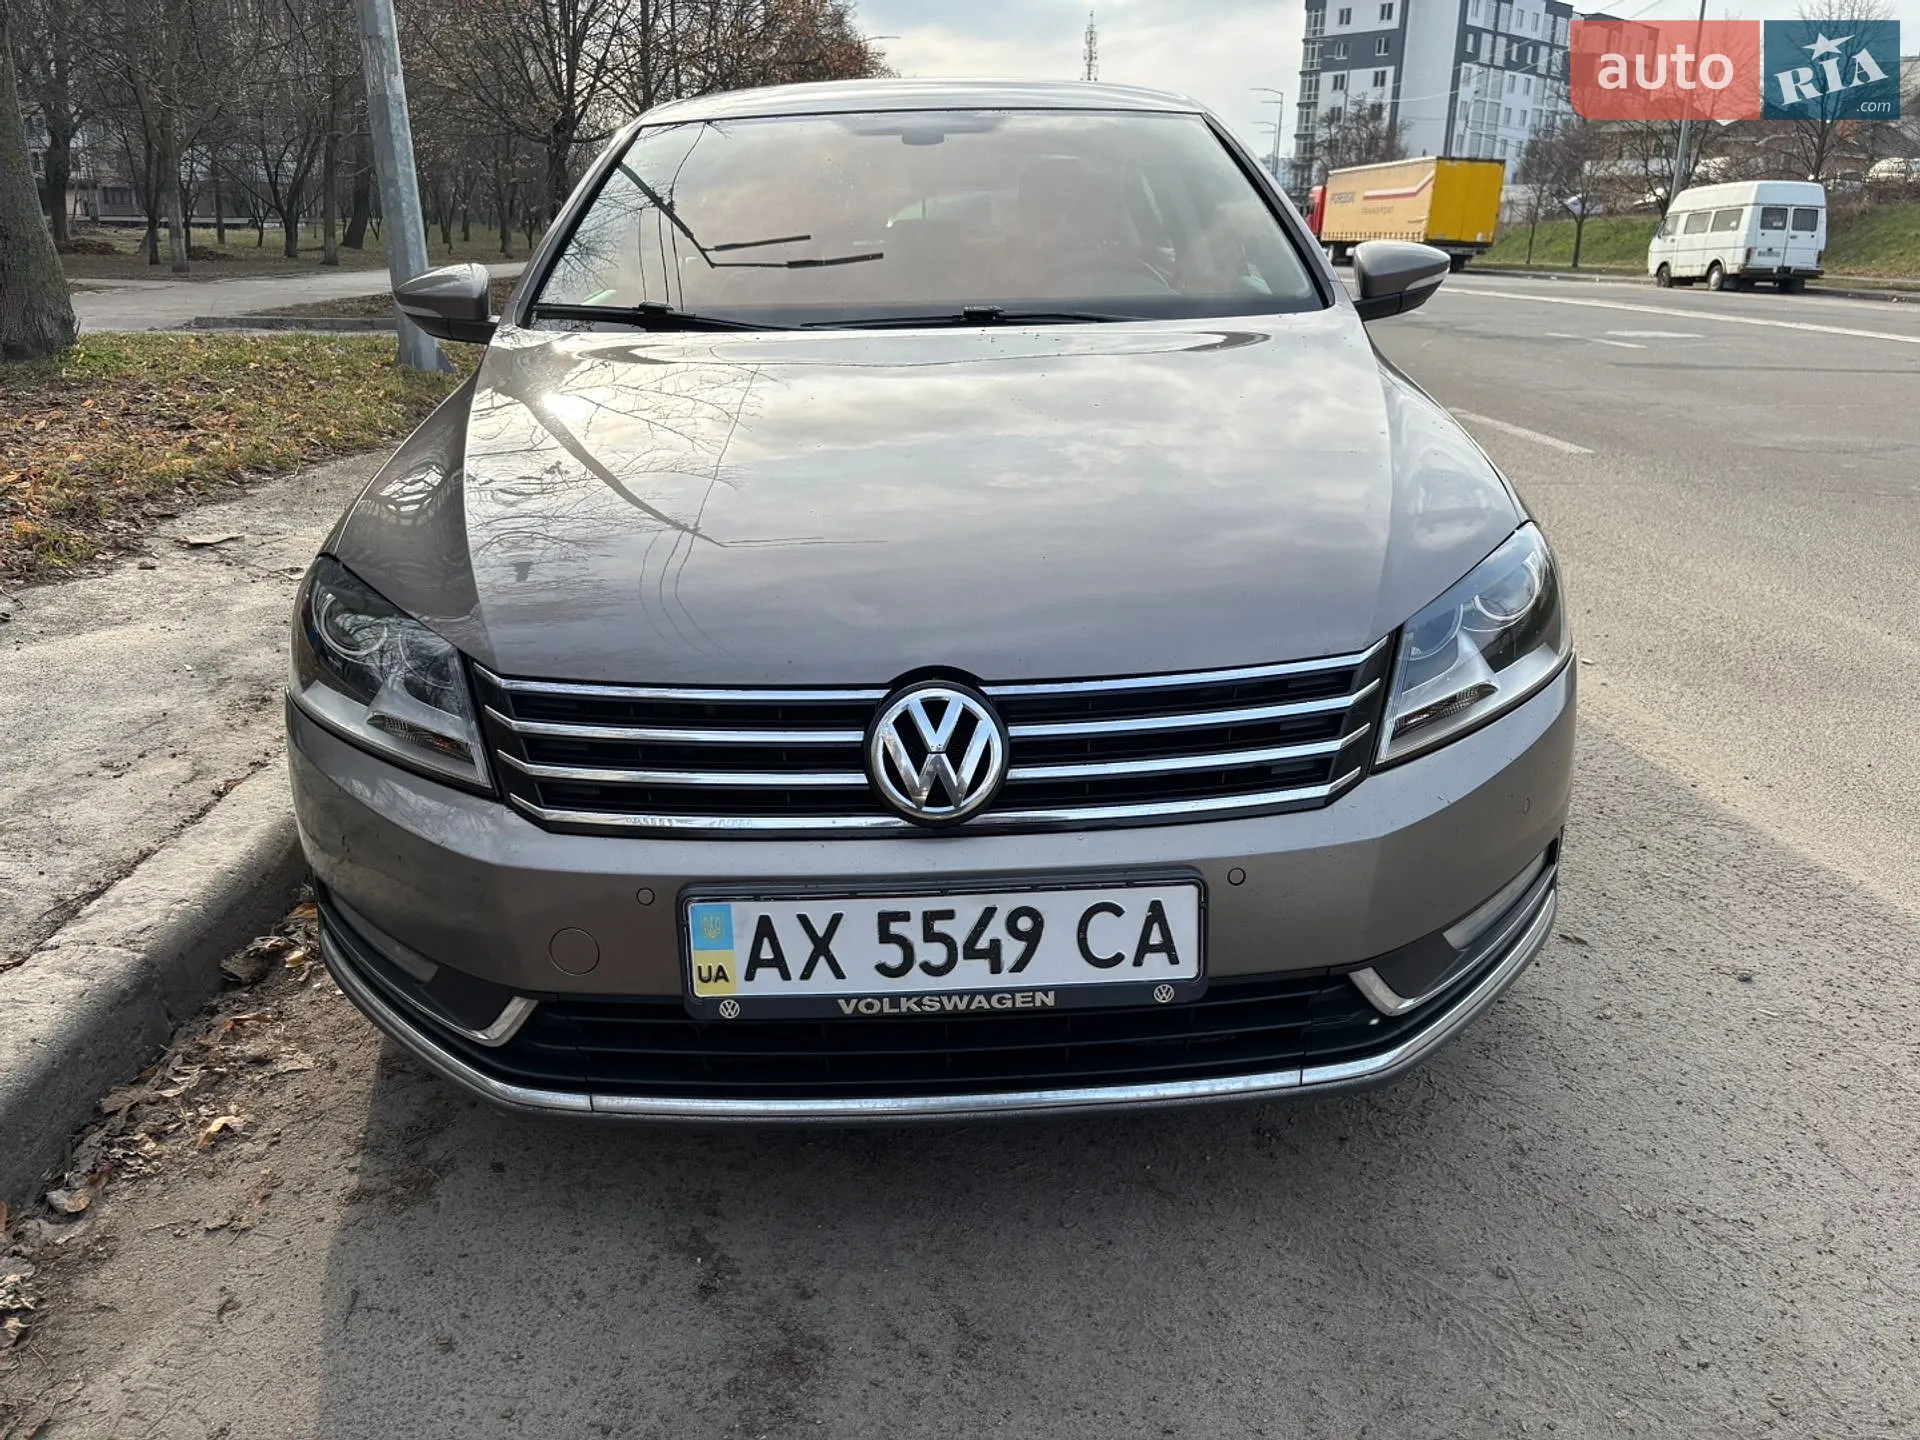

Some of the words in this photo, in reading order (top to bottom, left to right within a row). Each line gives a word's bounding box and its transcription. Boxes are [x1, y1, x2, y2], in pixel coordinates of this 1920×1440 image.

[744, 912, 847, 982] AX
[874, 905, 1045, 979] 5549
[1077, 899, 1180, 969] CA
[697, 965, 730, 984] UA
[837, 990, 1056, 1015] VOLKSWAGEN
